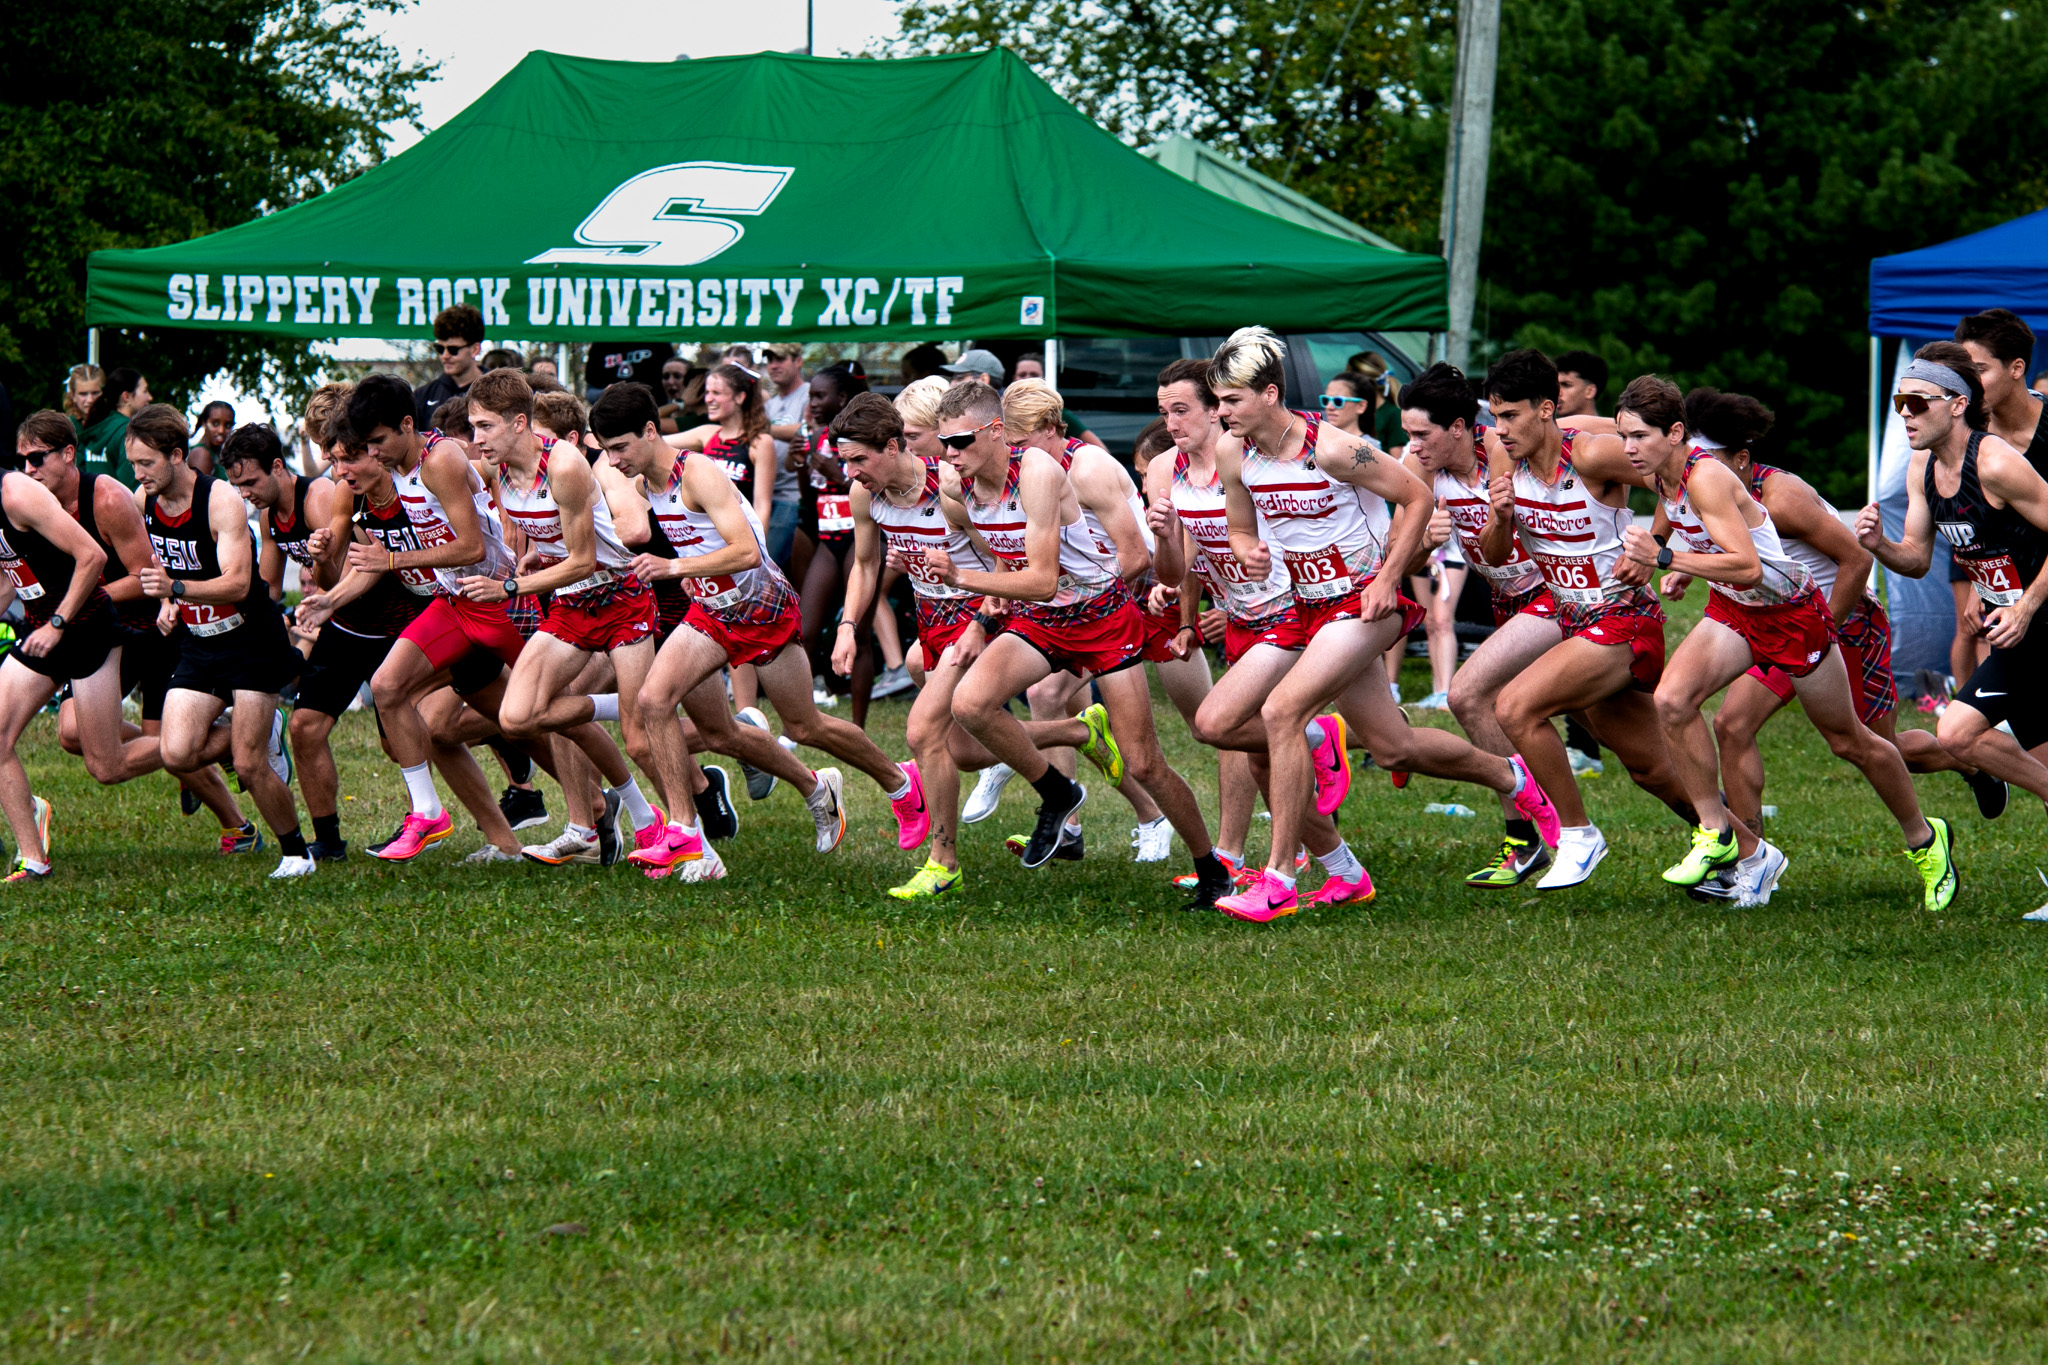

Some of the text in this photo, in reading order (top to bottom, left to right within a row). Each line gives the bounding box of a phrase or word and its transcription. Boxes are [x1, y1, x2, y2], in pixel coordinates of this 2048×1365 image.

[167, 273, 381, 325] SLIPPERY
[527, 277, 804, 327] UNIVERSITY
[817, 276, 964, 326] XC/TF
[822, 502, 841, 519] 41
[1305, 545, 1337, 560] CREEK
[1558, 556, 1592, 566] CREEK
[400, 567, 431, 585] 81
[909, 563, 940, 584] 98
[1292, 557, 1337, 584] 103
[1545, 564, 1589, 588] 106
[1968, 566, 2011, 590] 124
[188, 604, 221, 624] 72
